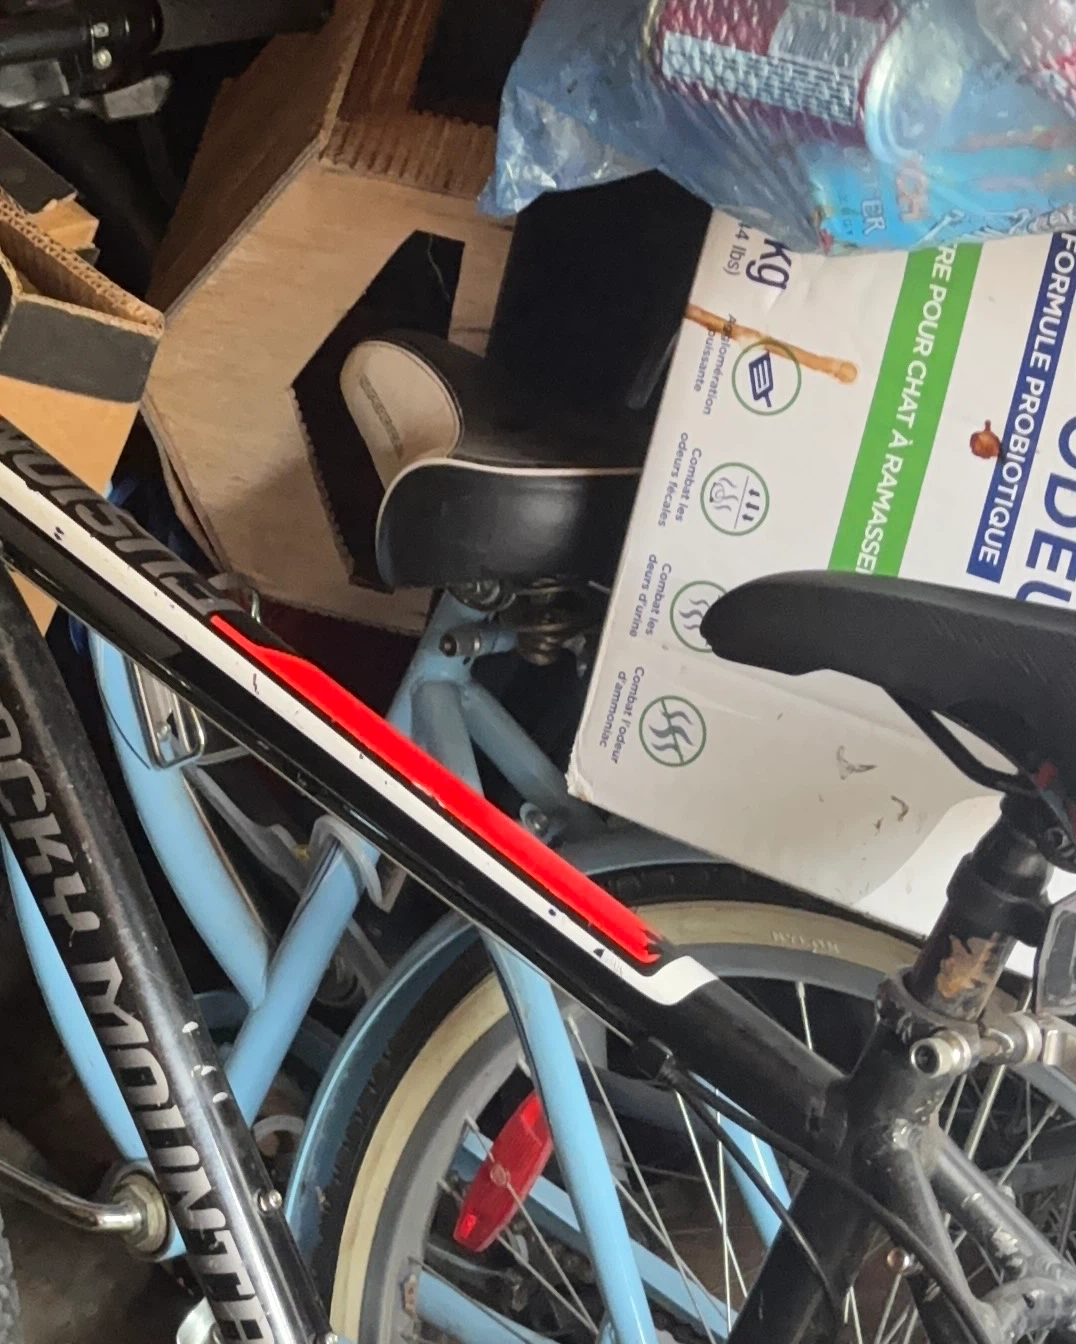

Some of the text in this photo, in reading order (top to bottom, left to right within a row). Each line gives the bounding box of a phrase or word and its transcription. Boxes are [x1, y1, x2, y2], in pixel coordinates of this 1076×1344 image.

[723, 245, 747, 276] lbs)
[912, 283, 947, 357] POUR
[896, 360, 927, 429] CHAT
[979, 231, 1076, 566] FORMULE PROBIOTIQUE
[891, 428, 914, 449] À
[654, 431, 694, 528] odeurs fécales
[671, 446, 705, 523] Combat les
[626, 593, 650, 639] d'urine
[642, 561, 674, 637] Combat les
[596, 670, 631, 749] d'ammoniac
[605, 664, 647, 772] Combat l'odeur
